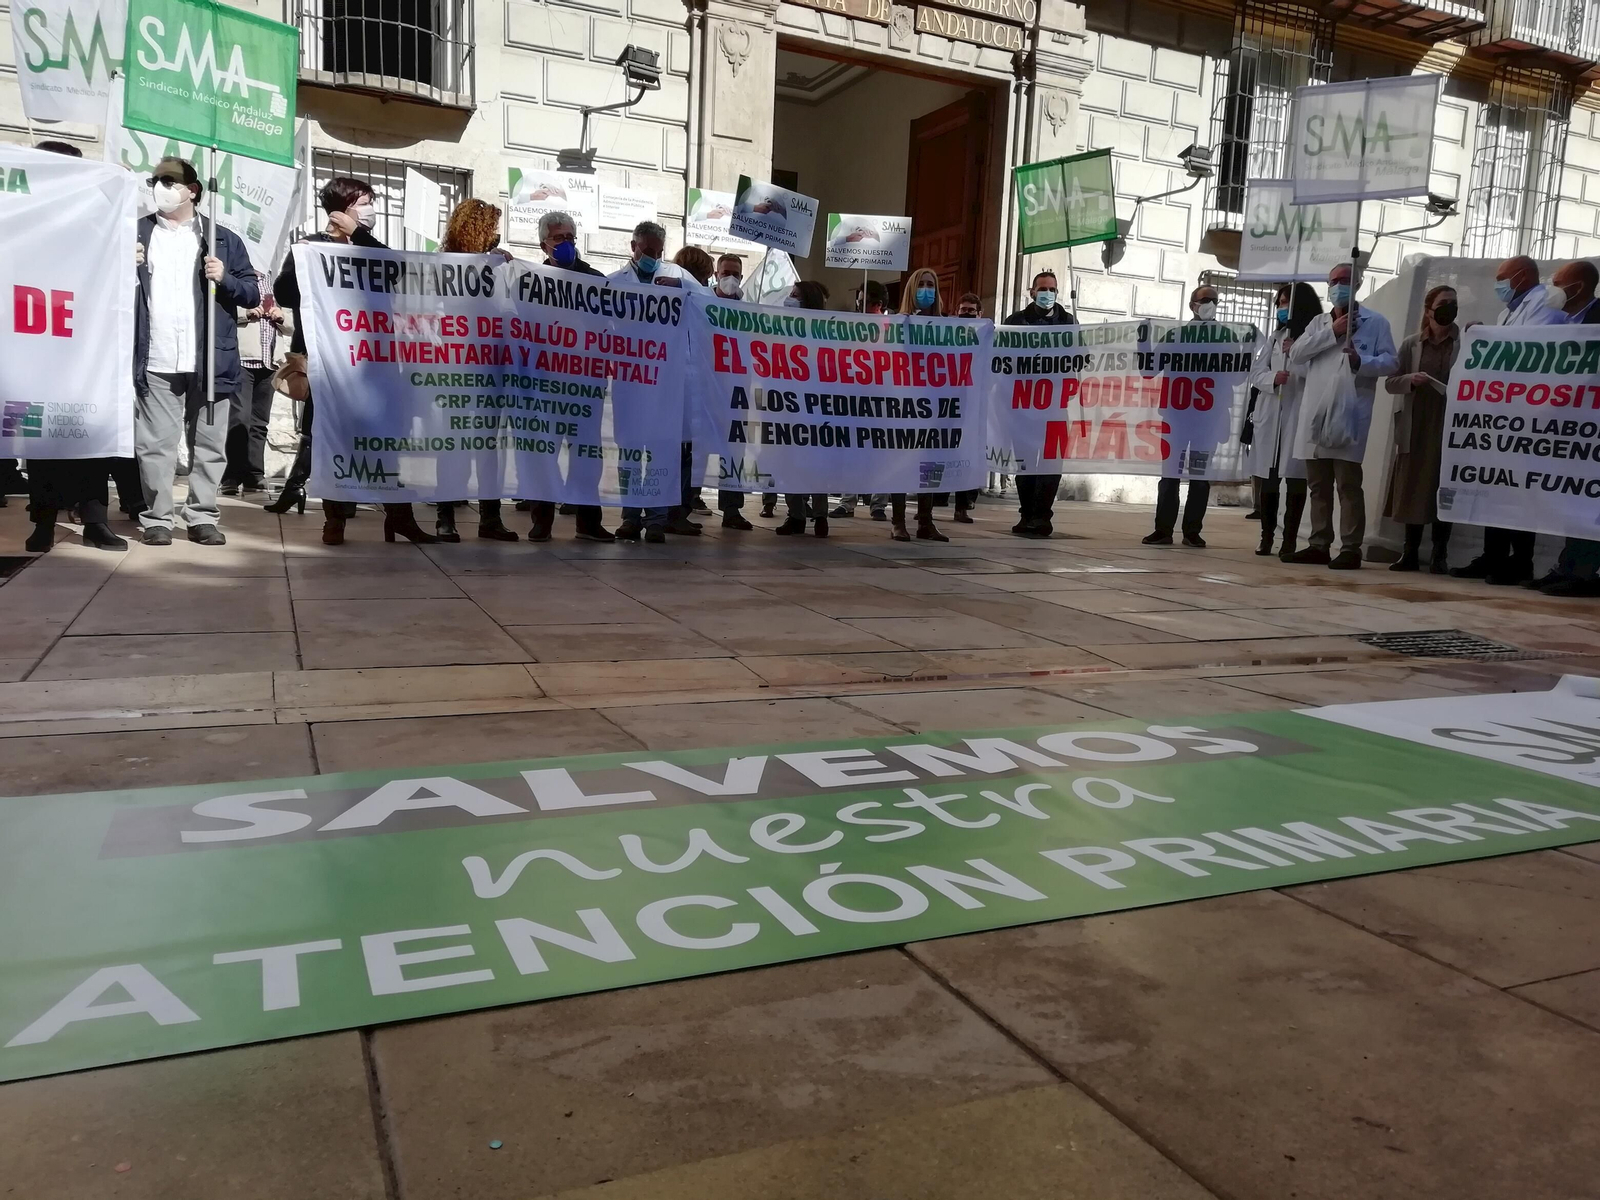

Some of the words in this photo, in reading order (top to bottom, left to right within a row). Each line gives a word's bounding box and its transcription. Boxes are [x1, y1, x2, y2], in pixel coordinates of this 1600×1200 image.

[866, 0, 892, 22] DE
[916, 8, 1022, 50] ANDALUCIA
[23, 5, 124, 89] SM
[136, 15, 280, 99] SMA
[139, 76, 189, 99] Sindicato
[191, 89, 231, 110] Médico
[232, 101, 274, 121] Andaluz
[231, 110, 284, 137] Málaga
[1303, 108, 1418, 160] SMA
[568, 178, 593, 190] SMA
[1375, 165, 1420, 177] Málaga
[234, 175, 275, 208] Sevilla
[790, 197, 813, 214] SMA
[1024, 176, 1104, 217] SMA
[509, 205, 548, 215] SALVEMOS
[1250, 200, 1348, 245] SMA
[687, 222, 722, 233] SALVEMOS
[732, 212, 767, 230] SALVEMOS
[768, 223, 798, 239] NUESTRA
[882, 220, 905, 233] SMA
[765, 232, 796, 249] PRIMARIA
[826, 247, 862, 255] SALVEMOS
[862, 249, 893, 257] NUESTRA
[1250, 244, 1281, 252] Sindicato
[860, 258, 893, 266] PRIMARIA
[320, 253, 495, 299] VETERINARIOS
[519, 271, 682, 327] FARMACÉUTICOS
[13, 284, 74, 338] DE
[705, 304, 806, 339] SINDICATO
[811, 315, 881, 343] MÉDICO
[884, 322, 905, 344] DE
[909, 320, 980, 346] MÁLAGA
[476, 316, 503, 340] DE
[510, 318, 578, 348] SALÚD
[584, 327, 668, 361] PÚBLICA
[1078, 324, 1148, 347] MÉDICO
[1153, 325, 1175, 344] DE
[349, 339, 514, 367] ¡ALIMENTARIA
[516, 345, 530, 368] Y
[536, 350, 659, 386] AMBIENTAL!
[713, 333, 747, 374] EL
[750, 340, 811, 382] SAS
[817, 346, 973, 387] DESPRECIA
[1016, 352, 1128, 375] MÉDICOS/AS
[1132, 351, 1155, 371] DE
[1159, 352, 1252, 373] PRIMARIA
[410, 371, 495, 388] CARRERA
[502, 373, 611, 400] PROFESIONA
[1012, 379, 1054, 411] NO
[1060, 376, 1215, 411] PODEMOS
[47, 402, 98, 414] SINDICATO
[435, 394, 471, 409] CRP
[476, 393, 593, 418] FACULTATIVOS
[730, 386, 749, 410] A
[754, 387, 800, 414] LOS
[804, 392, 932, 419] PEDIATRAS
[937, 397, 961, 419] DE
[47, 413, 85, 426] MÉDICO
[450, 414, 548, 435] REGULACIÓN
[555, 420, 578, 437] DE
[1452, 412, 1525, 433] MARCO
[1531, 417, 1600, 440] LABO
[354, 436, 455, 452] HORARIOS
[460, 437, 556, 455] NOCTURNOS
[728, 420, 850, 449] ATENCIÓN
[856, 426, 963, 450] PRIMARIA
[1043, 412, 1171, 460] MÁS
[1447, 431, 1493, 451] LAS
[333, 453, 400, 484] SMA
[1450, 464, 1520, 489] IGUAL
[1431, 715, 1600, 765] SM
[180, 724, 1260, 843] SALVEMOS
[462, 775, 1176, 899] nuestra
[3, 858, 1050, 1048] ATENCIÓN
[1038, 797, 1600, 890] PRIMARIA
